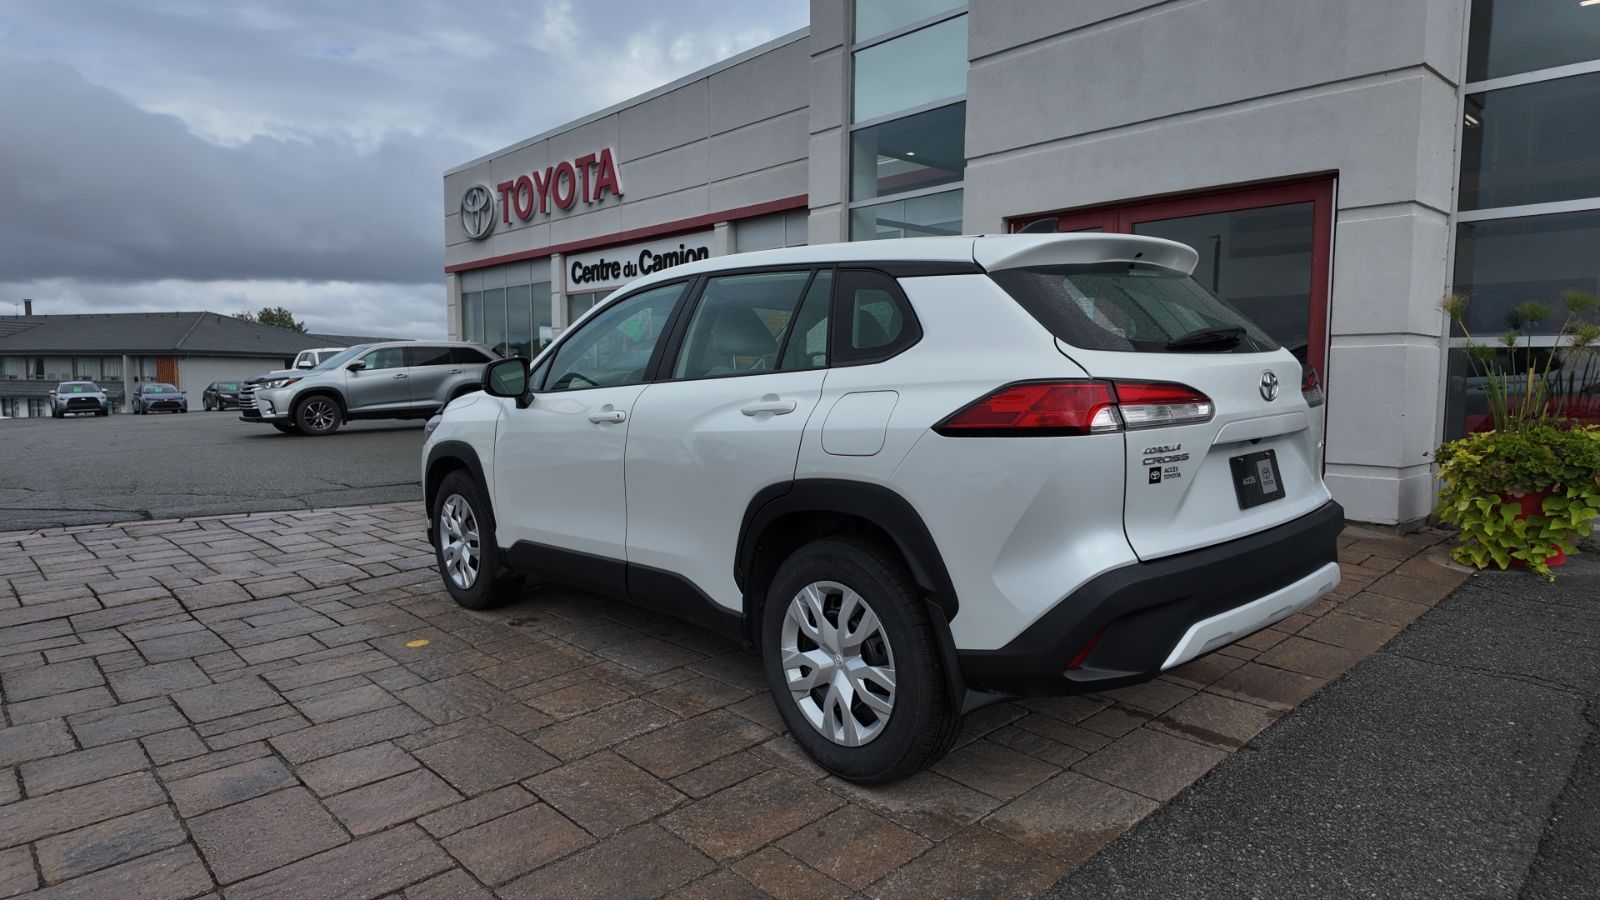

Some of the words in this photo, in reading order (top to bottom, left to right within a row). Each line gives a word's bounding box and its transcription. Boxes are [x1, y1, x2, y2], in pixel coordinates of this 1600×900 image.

[497, 147, 623, 224] TOYOTA
[571, 258, 620, 284] Centre
[623, 261, 637, 278] du
[638, 244, 709, 275] Camion
[1143, 444, 1181, 454] COROLLA
[1142, 453, 1189, 465] CROSS
[1163, 472, 1181, 480] TOYOTA
